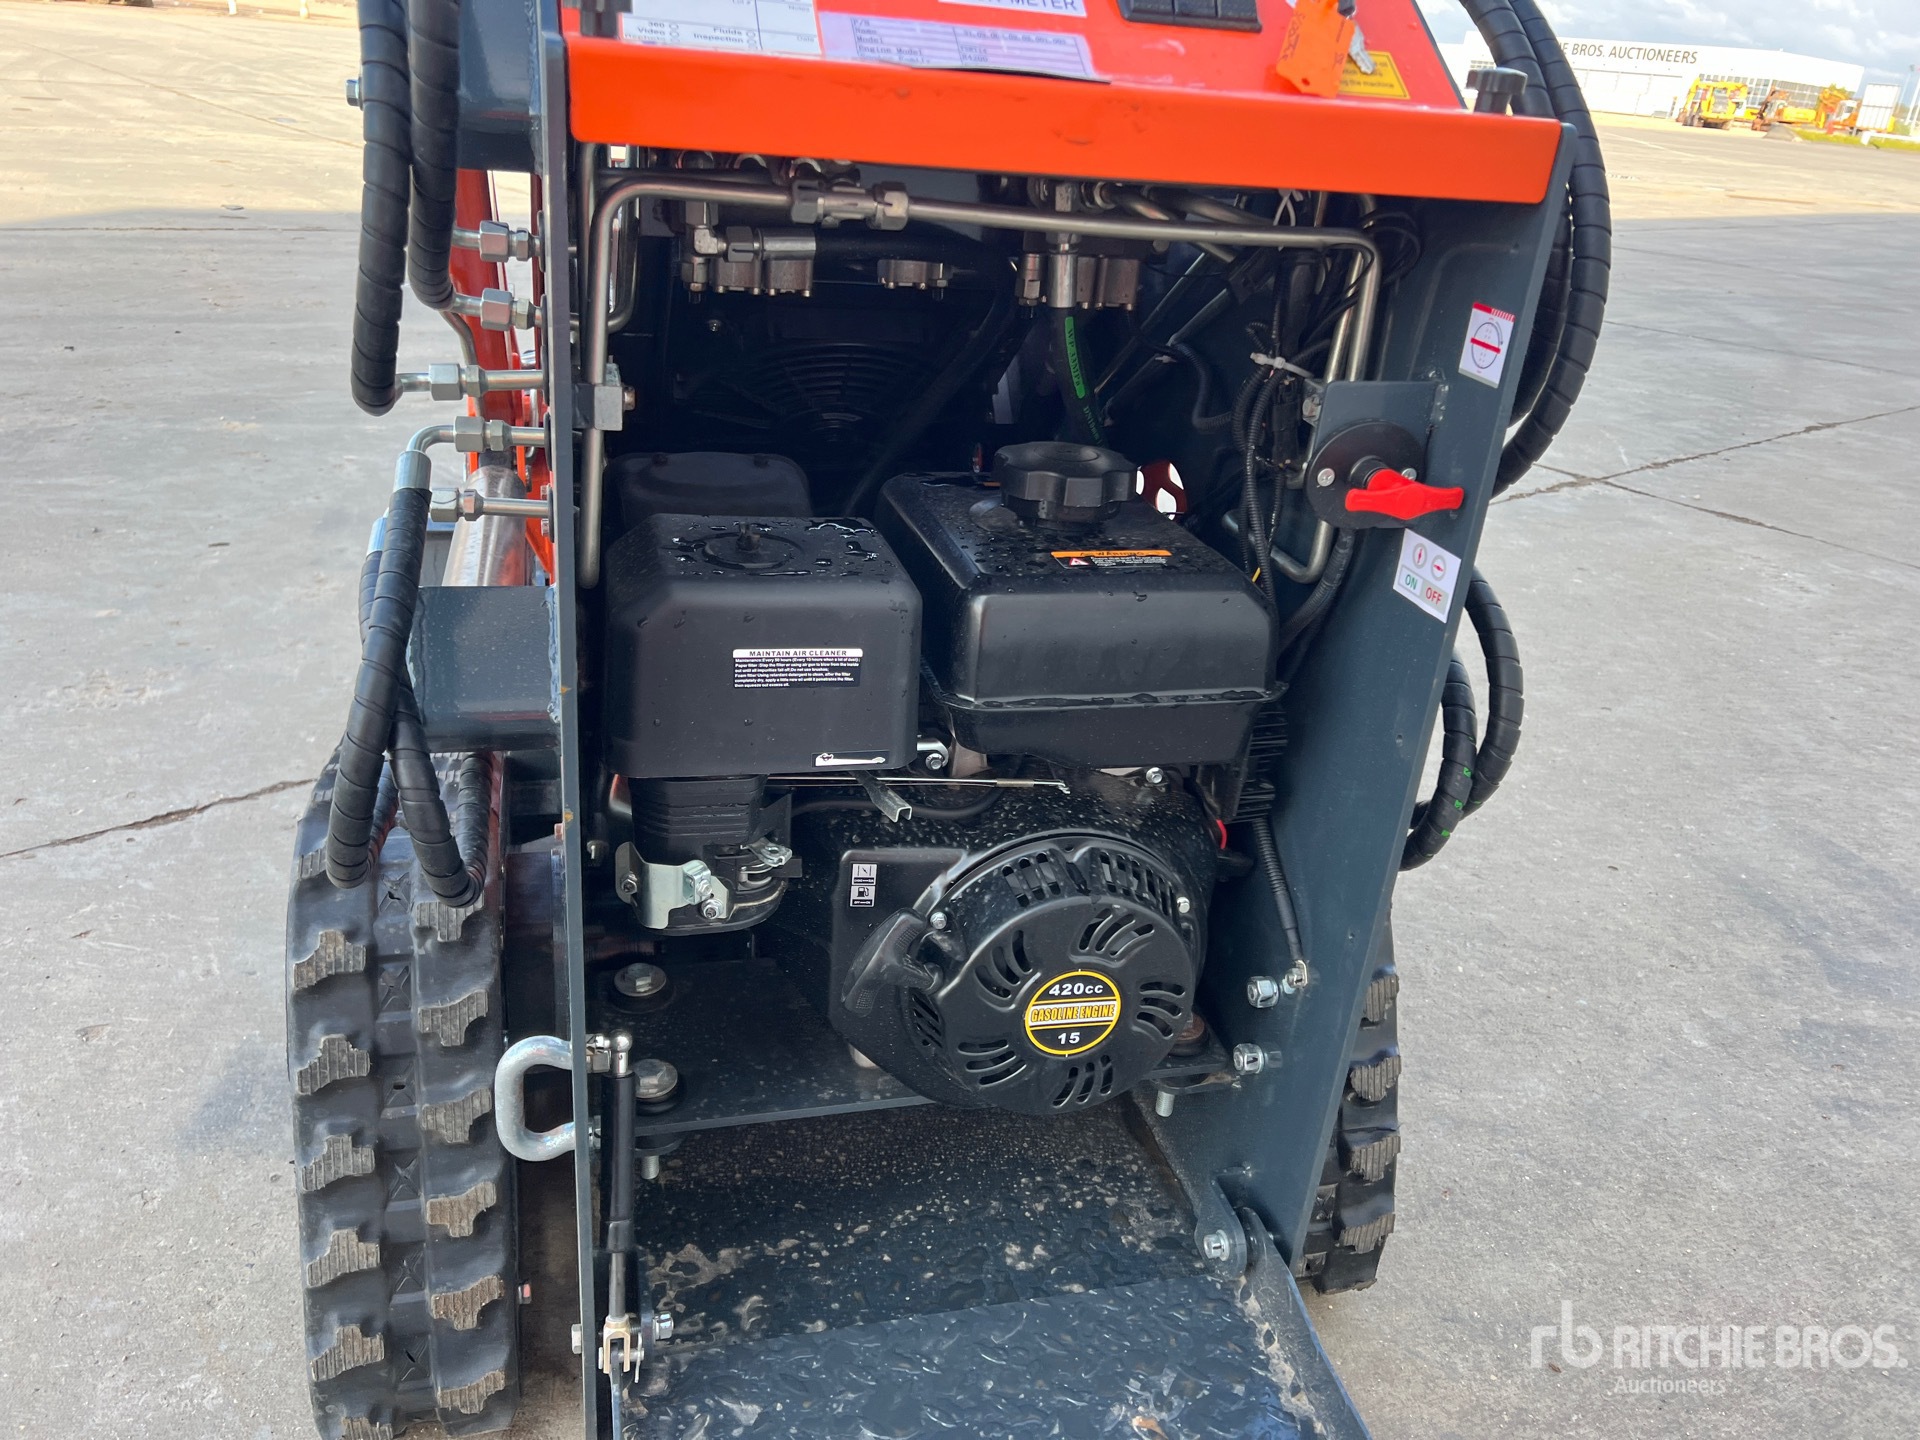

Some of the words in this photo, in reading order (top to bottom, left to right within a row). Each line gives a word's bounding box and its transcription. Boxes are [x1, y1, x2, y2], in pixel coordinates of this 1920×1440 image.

[637, 26, 666, 35] Video
[693, 33, 744, 43] Inspection
[1571, 43, 1605, 57] BROS.
[1608, 46, 1698, 64] AUCTIONEERS
[1405, 574, 1418, 590] ON
[1425, 587, 1443, 605] OFF
[1048, 982, 1104, 996] 420cc
[1031, 1006, 1079, 1022] GASOLINE
[1080, 1004, 1115, 1019] ENGINE
[1058, 1032, 1080, 1045] 15
